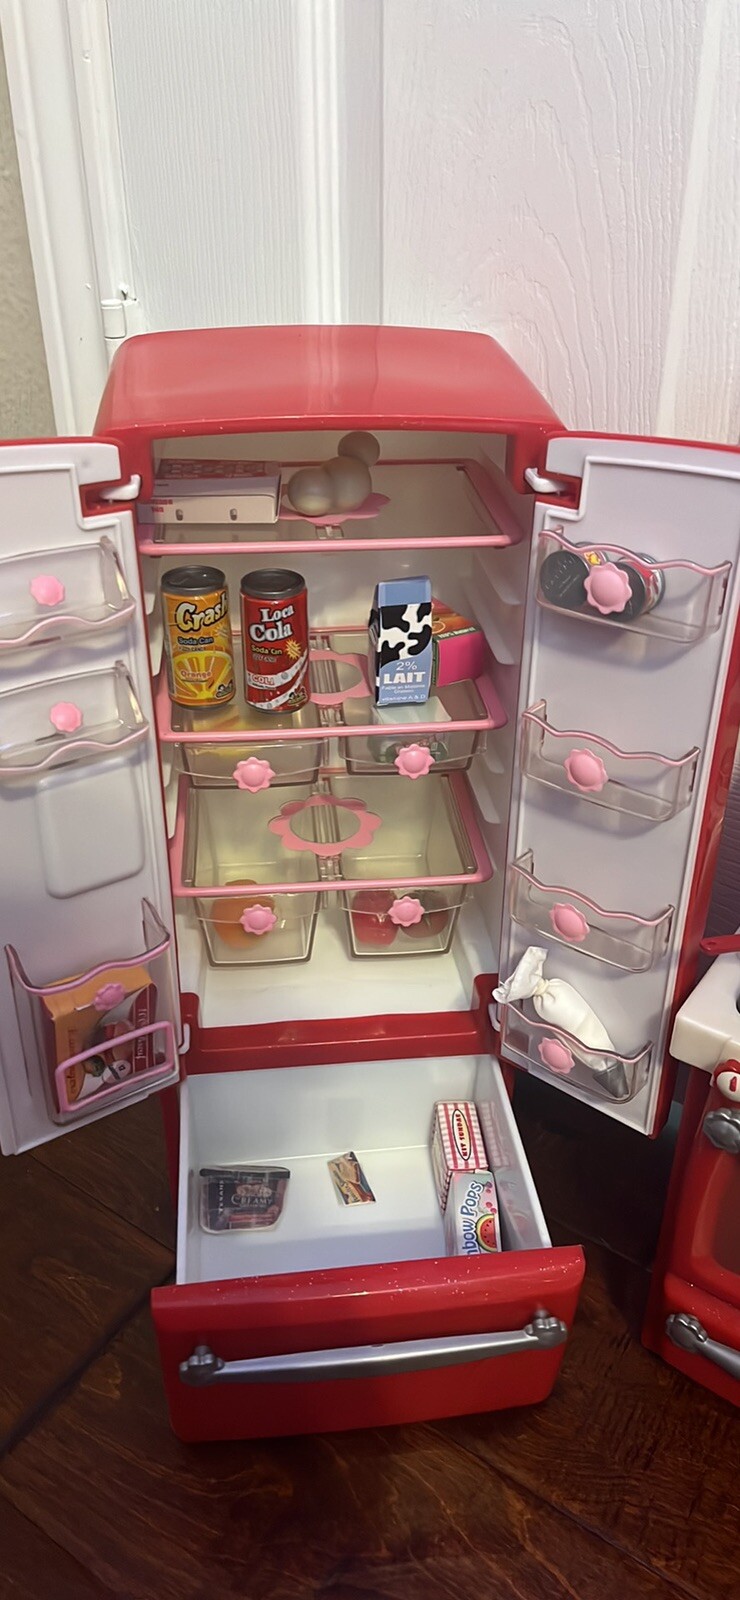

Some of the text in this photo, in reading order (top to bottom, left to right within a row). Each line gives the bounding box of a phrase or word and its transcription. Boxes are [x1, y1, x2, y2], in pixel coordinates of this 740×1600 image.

[260, 604, 295, 622] Loca
[249, 621, 293, 642] Cola
[178, 636, 214, 645] Soda Can
[251, 644, 269, 654] Soda
[396, 661, 418, 671] 2%
[180, 669, 212, 679] Orange
[383, 671, 426, 684] LAIT
[460, 1142, 468, 1157] KIT
[460, 1181, 483, 1255] nbow Pops
